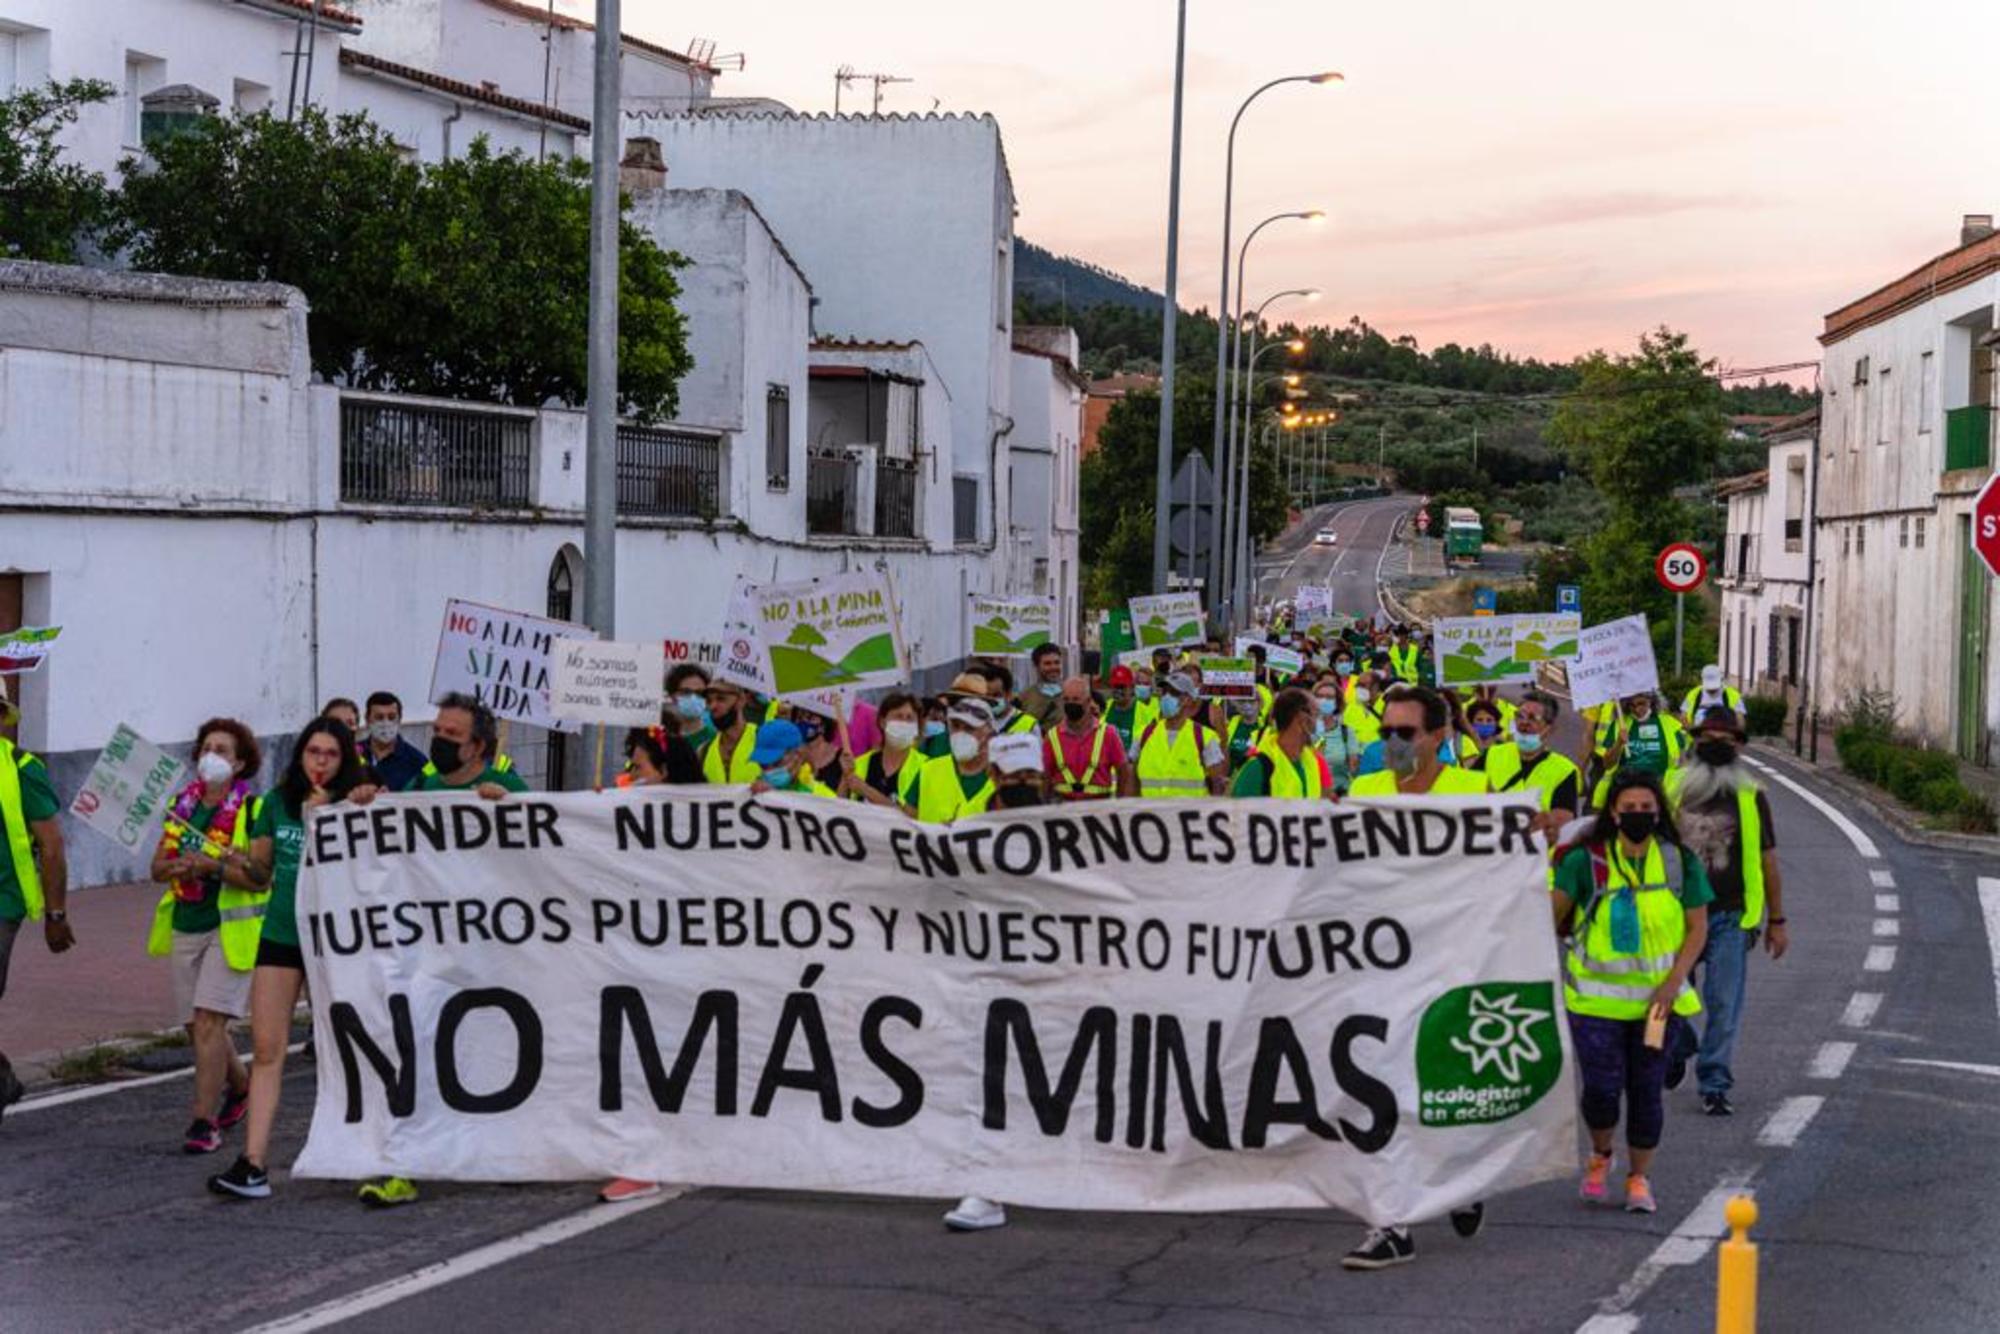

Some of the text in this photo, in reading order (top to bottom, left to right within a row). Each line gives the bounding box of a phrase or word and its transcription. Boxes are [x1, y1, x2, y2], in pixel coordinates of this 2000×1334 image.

[1669, 560, 1695, 575] 50
[761, 589, 883, 622] NO A LA MINA
[449, 612, 477, 635] NO
[565, 646, 584, 669] No
[663, 640, 688, 660] NO
[728, 658, 757, 679] ZONA
[475, 683, 532, 717] VIDA
[73, 790, 99, 818] NO
[306, 803, 564, 867] EFENDER
[614, 799, 867, 862] NUESTRO
[890, 812, 1171, 877] ENTORNO
[1179, 811, 1236, 864] ES
[1249, 805, 1539, 868] DEFENDER
[591, 897, 854, 951] PUEBLOS
[870, 905, 899, 952] Y
[916, 910, 1171, 971] NUESTRO
[1188, 916, 1412, 982] FUTURO
[329, 963, 1398, 1154] NO MÁS MINAS
[1423, 1107, 1447, 1120] en
